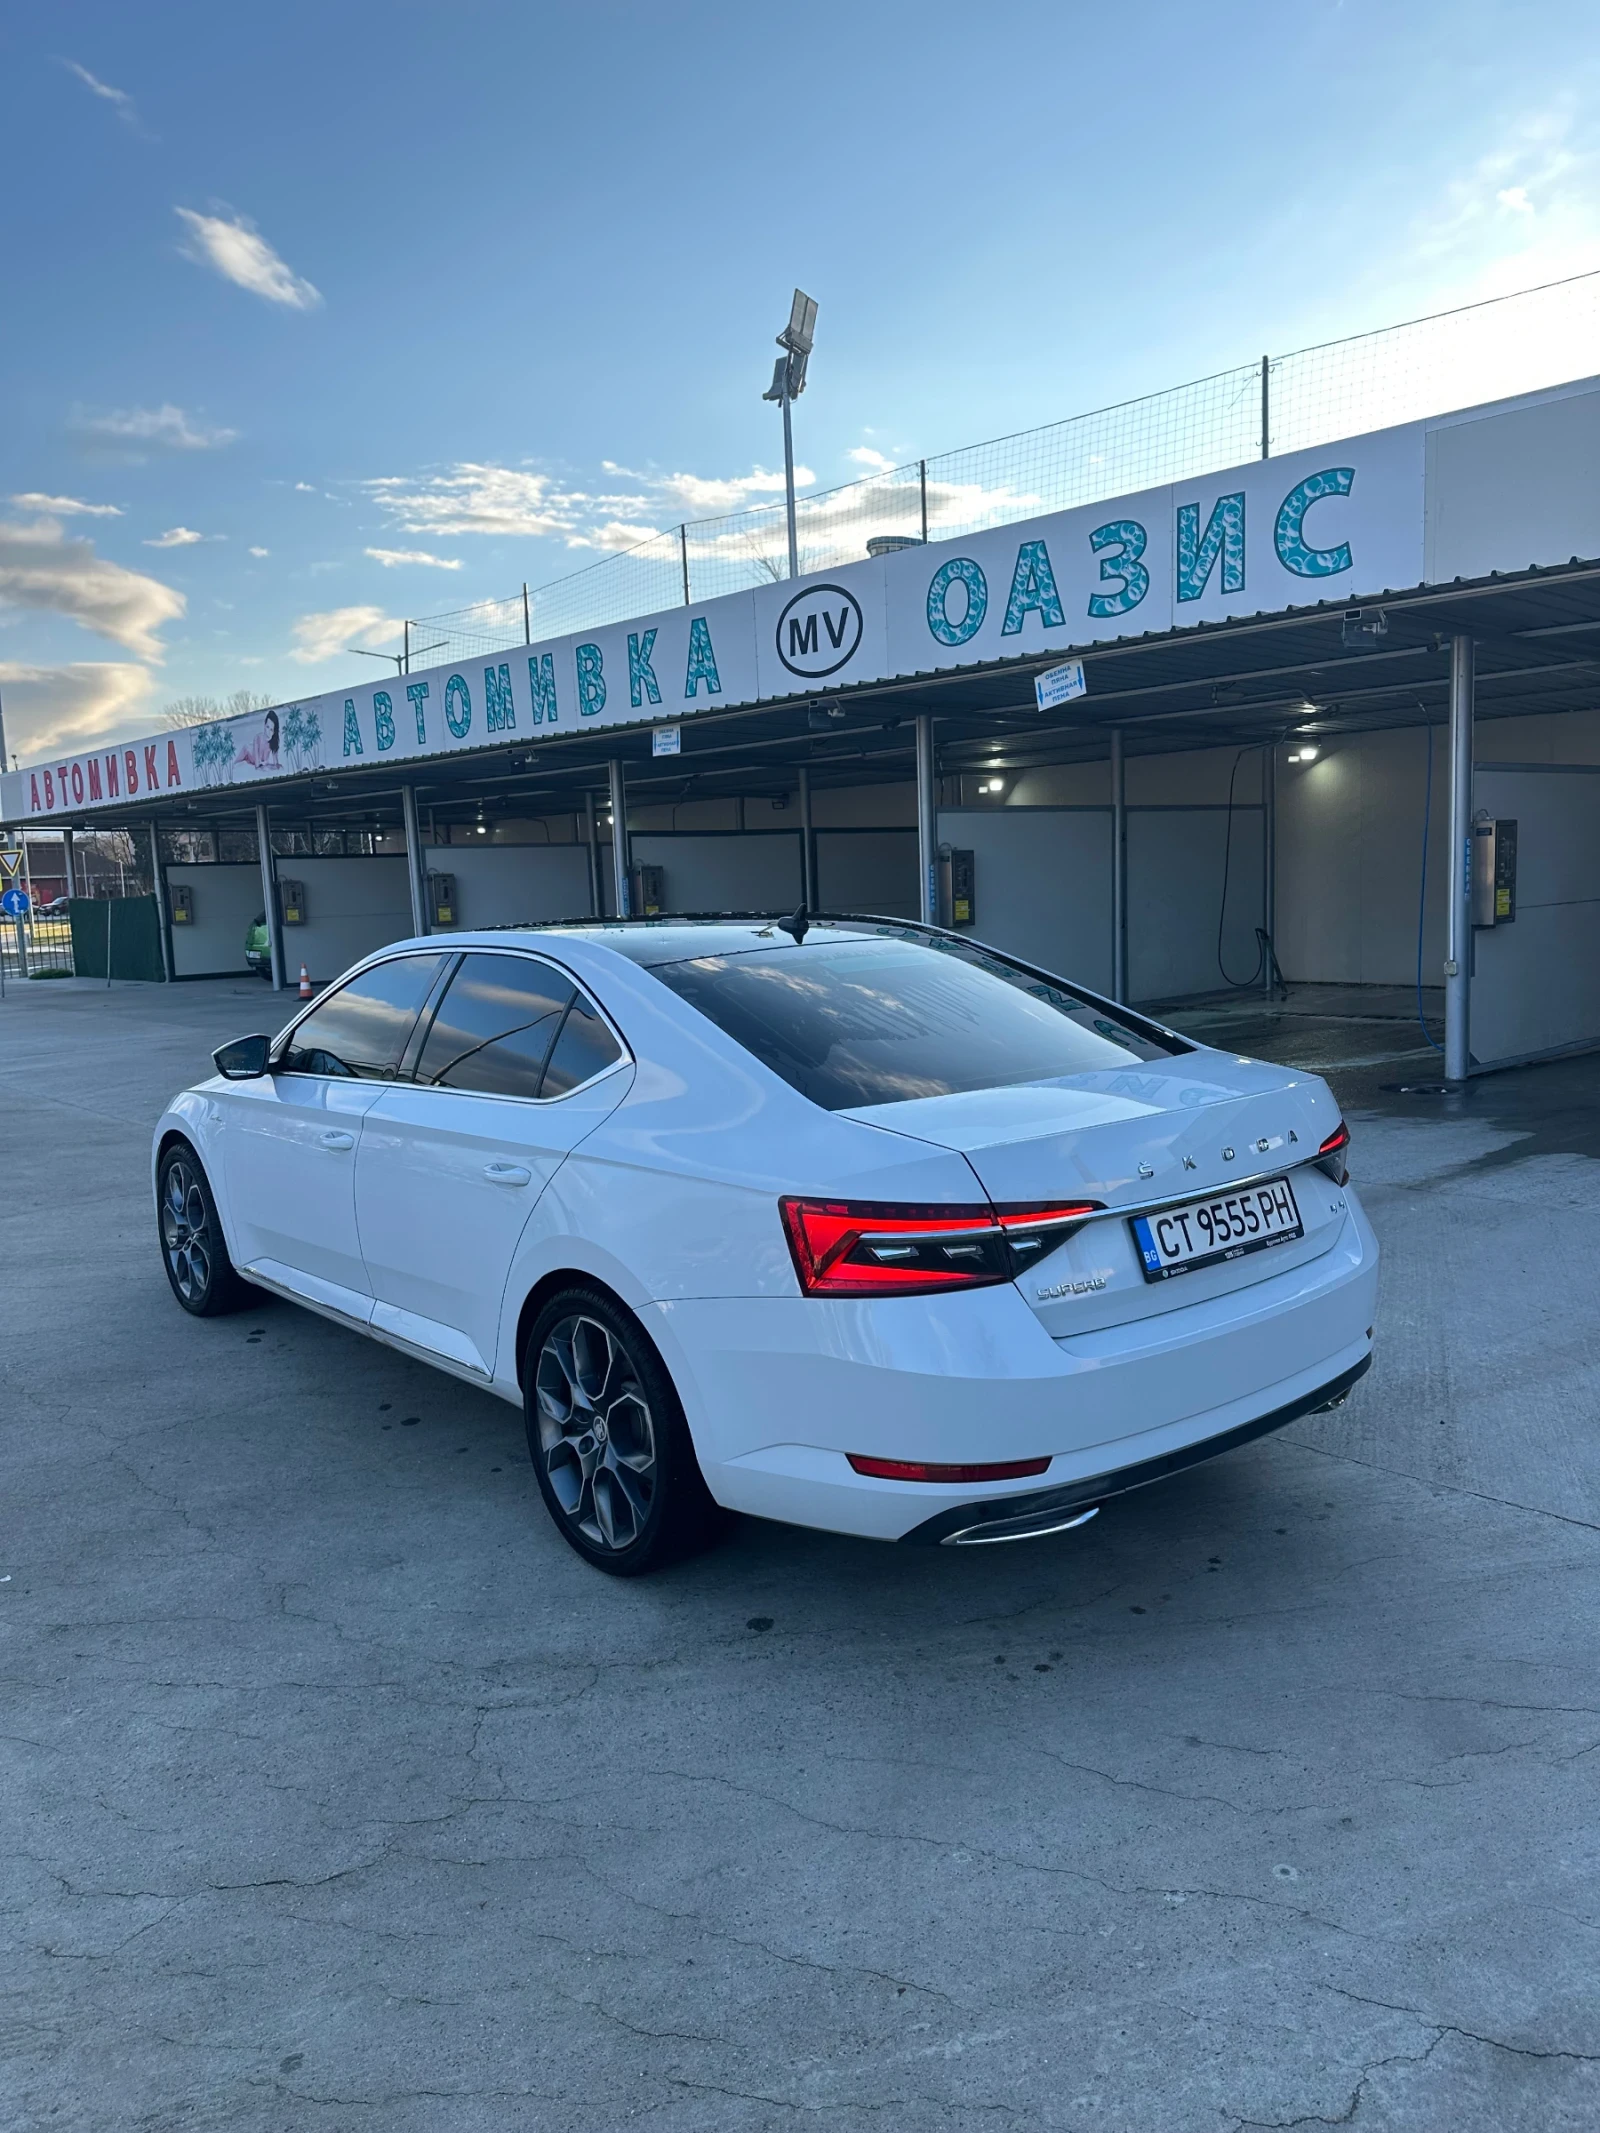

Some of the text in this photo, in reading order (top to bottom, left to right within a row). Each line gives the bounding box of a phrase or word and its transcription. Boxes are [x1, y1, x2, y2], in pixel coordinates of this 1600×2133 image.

[926, 467, 1355, 647] ОАЗИС
[789, 607, 850, 657] MV
[1045, 665, 1072, 680] ОБЕМНА
[1051, 674, 1069, 685] ПЯНА
[343, 617, 722, 757] АВТОМИВКА
[1044, 680, 1078, 698] АКТИВНАЯ
[1052, 691, 1070, 702] ПЕНА
[31, 740, 181, 812] АВТОМИВКА
[1156, 1187, 1294, 1258] CT 9555 PH
[1143, 1250, 1158, 1264] BG
[1037, 1277, 1106, 1300] SUPERB
